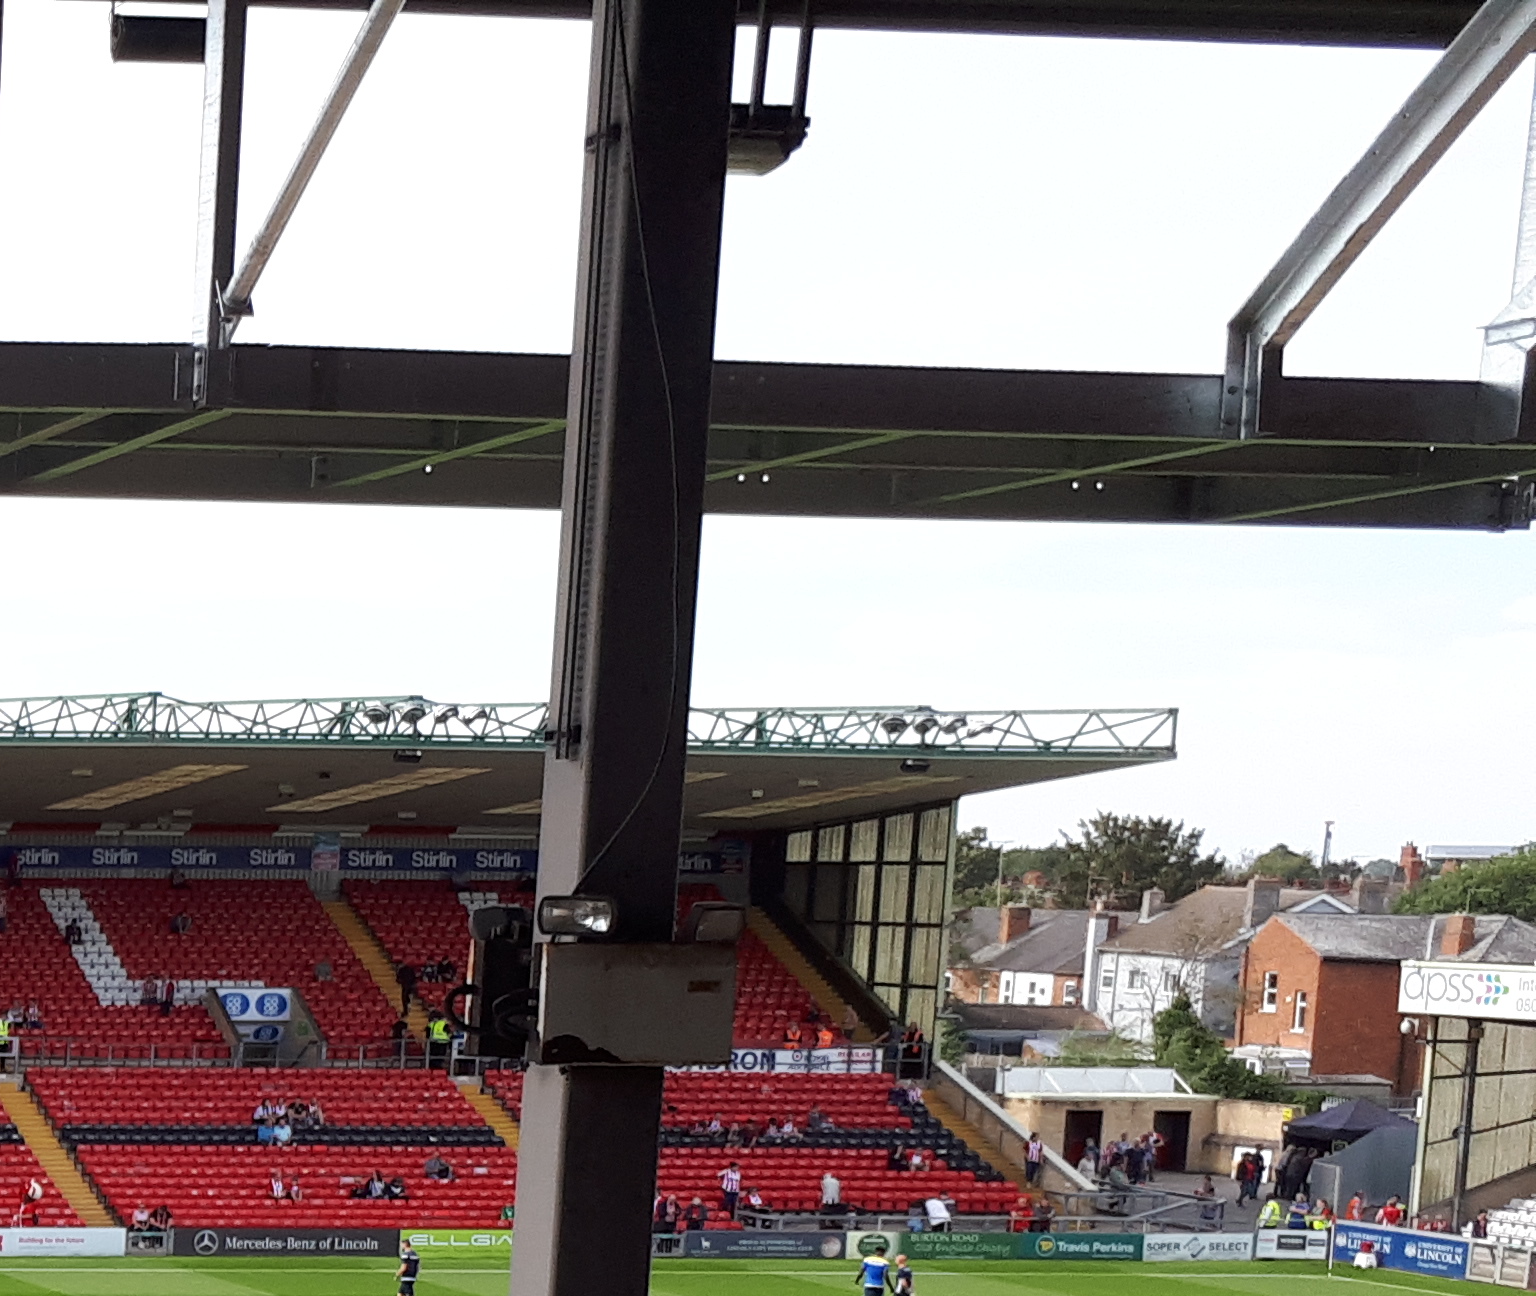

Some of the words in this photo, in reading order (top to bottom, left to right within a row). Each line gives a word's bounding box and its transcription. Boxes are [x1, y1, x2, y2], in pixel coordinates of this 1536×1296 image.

[92, 848, 138, 866] Stirlin
[171, 849, 217, 867] Stirlin
[250, 849, 296, 868] Stirlin
[348, 850, 393, 869] Stirlin
[412, 850, 457, 869] Stirlin
[476, 850, 521, 869] Stirlin
[225, 1236, 316, 1251] Mercedes-Benz
[318, 1236, 333, 1251] of
[333, 1236, 379, 1251] Lincoln
[951, 1233, 979, 1243] ROAD
[1057, 1240, 1090, 1253] Travis
[1092, 1241, 1135, 1254] Perkins
[1146, 1242, 1181, 1252] SOPER
[1208, 1241, 1249, 1252] SELECT
[1416, 1249, 1463, 1266] LINCOLN
